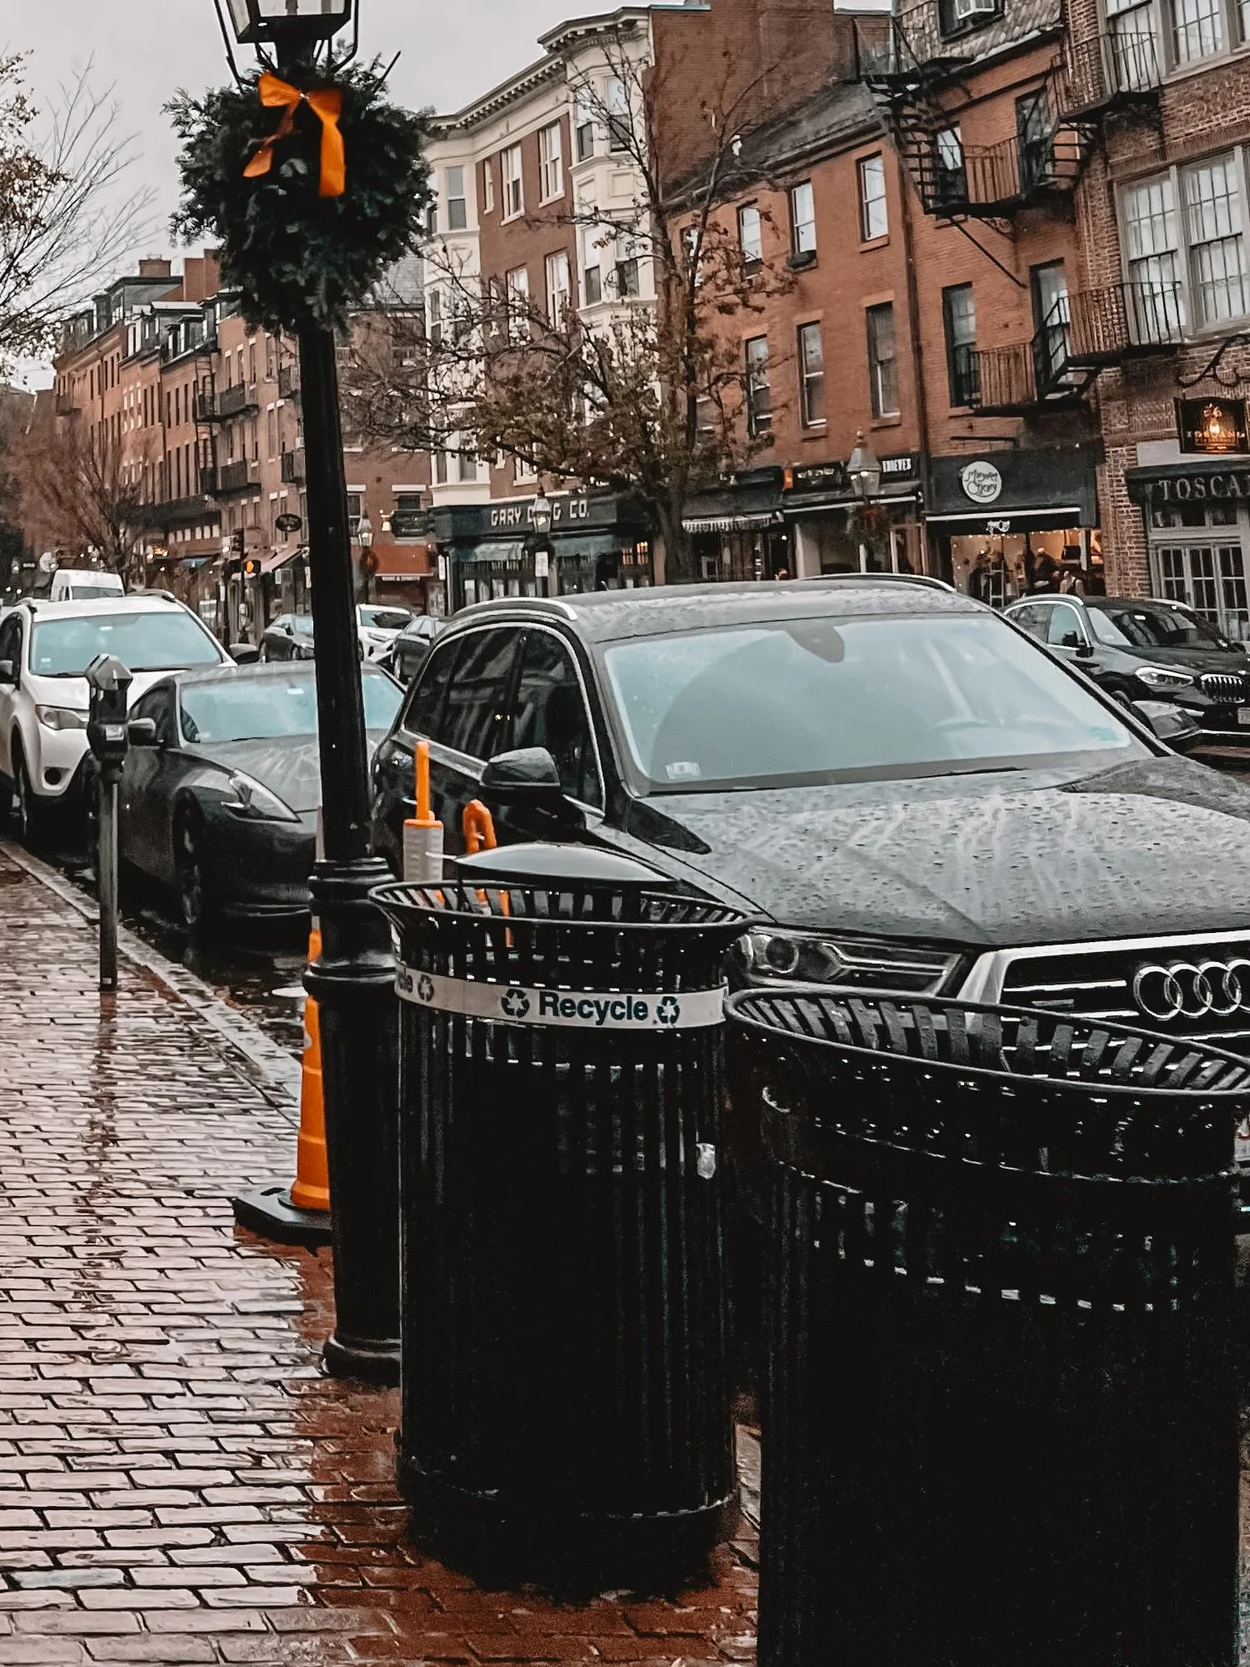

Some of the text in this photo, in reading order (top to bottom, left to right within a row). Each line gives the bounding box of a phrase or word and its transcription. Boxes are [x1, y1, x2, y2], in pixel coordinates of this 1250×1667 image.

[1158, 475, 1250, 501] TOSCA
[490, 499, 590, 527] GARY DG CO.
[538, 990, 648, 1026] Recycle
